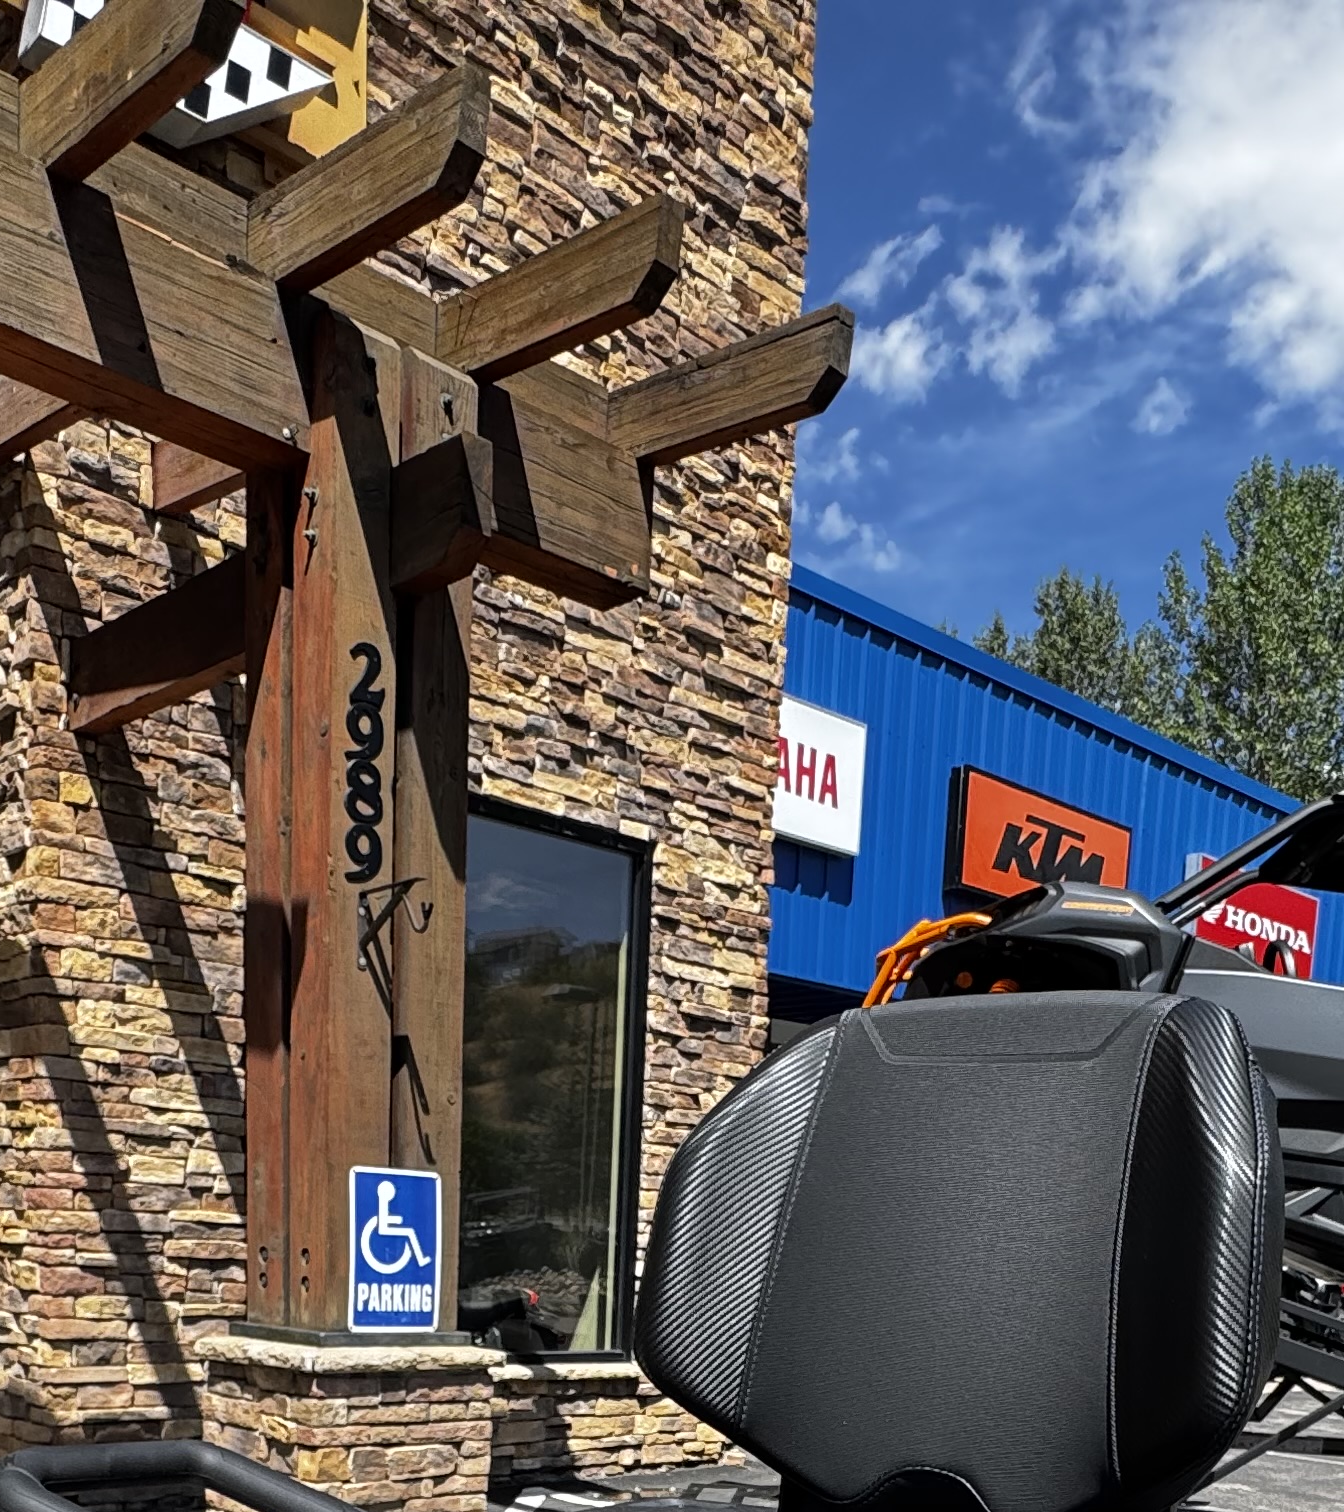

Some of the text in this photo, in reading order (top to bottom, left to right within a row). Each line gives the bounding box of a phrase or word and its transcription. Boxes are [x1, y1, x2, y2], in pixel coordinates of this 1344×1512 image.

[343, 641, 386, 884] 2989
[992, 815, 1105, 886] KTM
[1224, 903, 1312, 955] HONDA
[356, 1283, 433, 1314] PARKING
